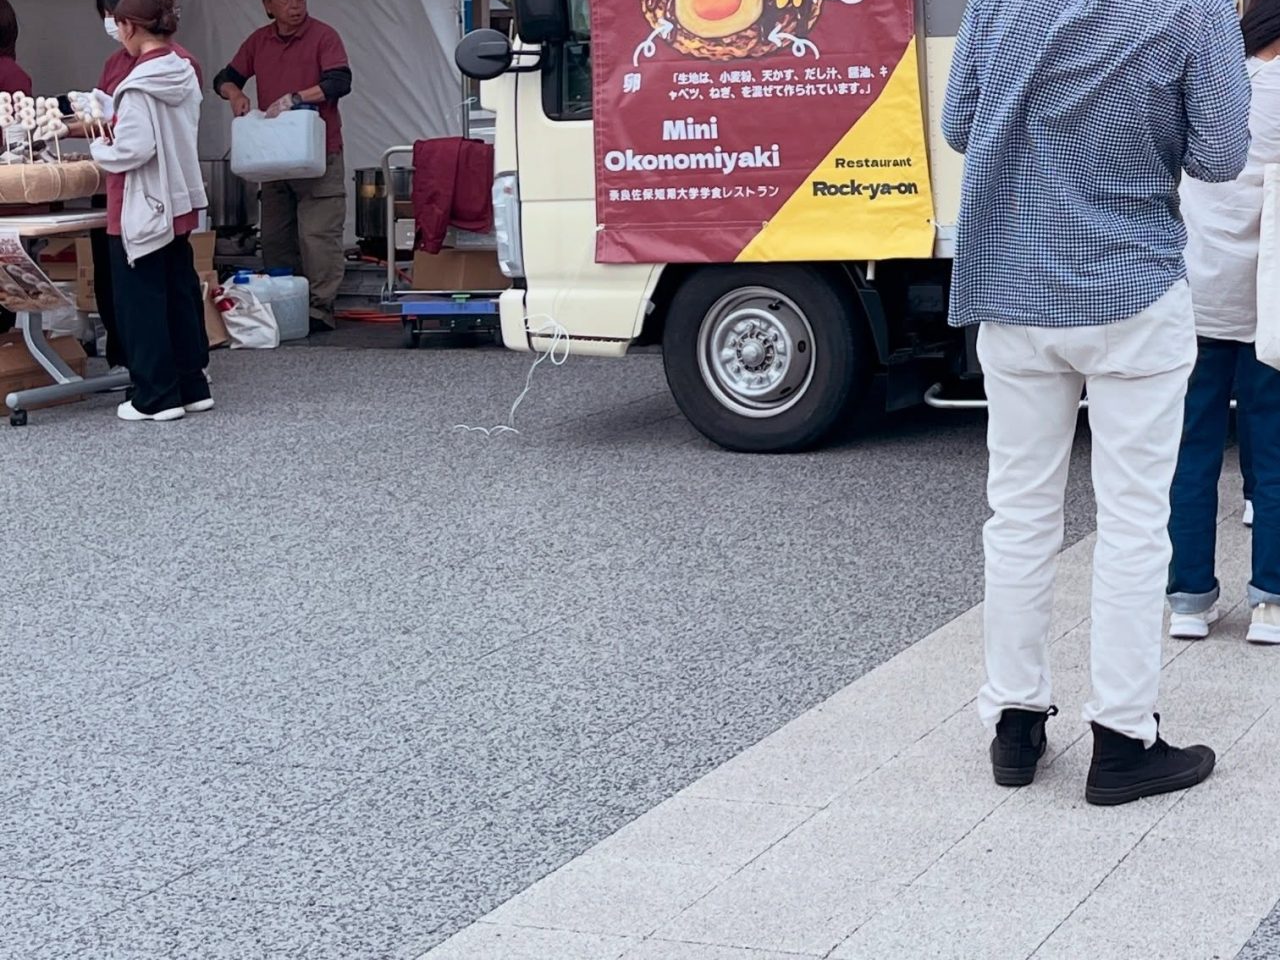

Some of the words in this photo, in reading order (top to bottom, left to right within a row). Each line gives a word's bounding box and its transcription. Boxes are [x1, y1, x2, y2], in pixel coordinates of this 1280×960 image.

[623, 72, 642, 93] 卵
[662, 116, 718, 141] Mini
[604, 144, 780, 174] Okonomiyaki
[835, 156, 912, 169] Restaurant
[609, 185, 779, 202] 奈良佐保短期大学学食レストラン
[812, 179, 918, 200] Rock-ya-on
